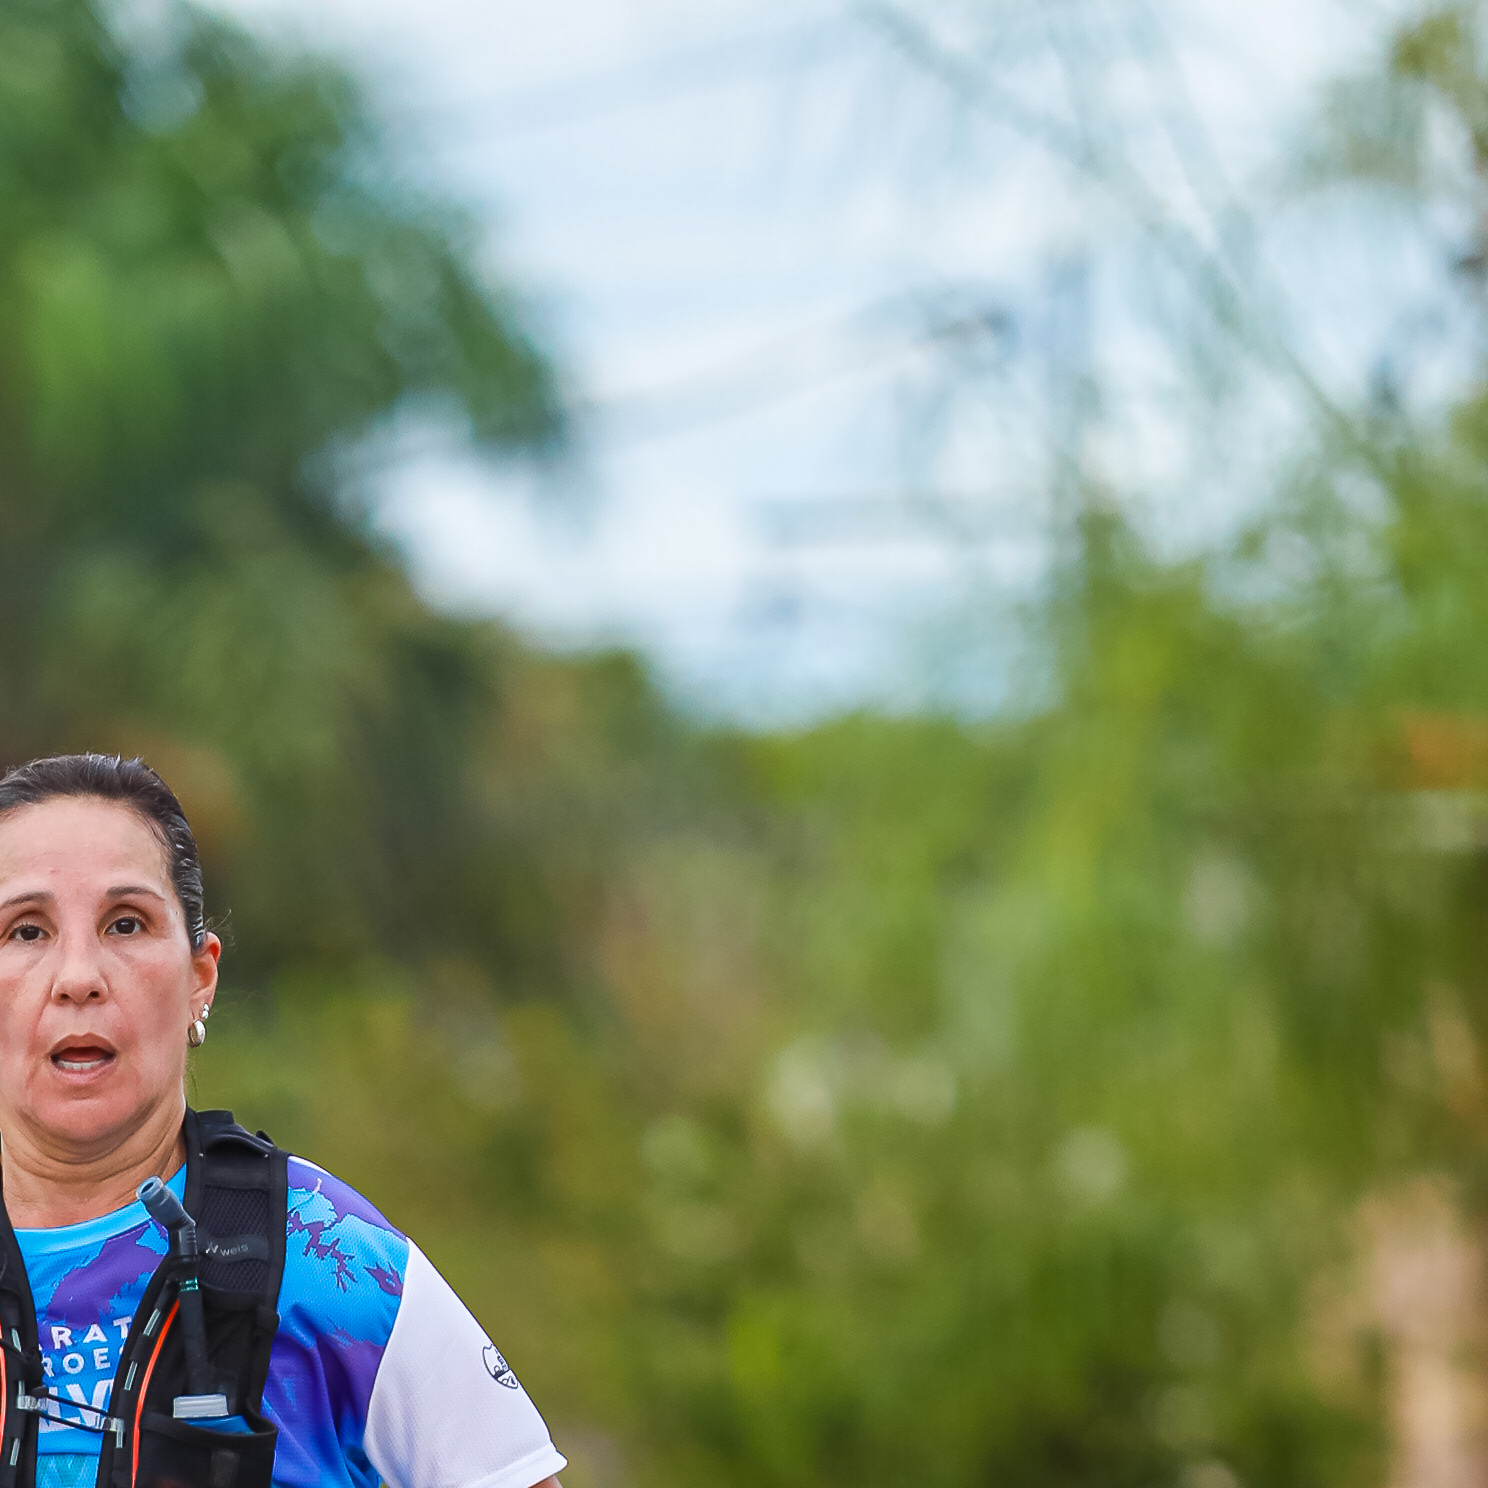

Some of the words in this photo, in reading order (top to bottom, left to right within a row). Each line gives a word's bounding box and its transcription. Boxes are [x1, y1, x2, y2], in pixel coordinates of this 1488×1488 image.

[38, 1316, 132, 1351] RAT
[41, 1345, 124, 1377] ROE
[38, 1378, 114, 1433] LV
